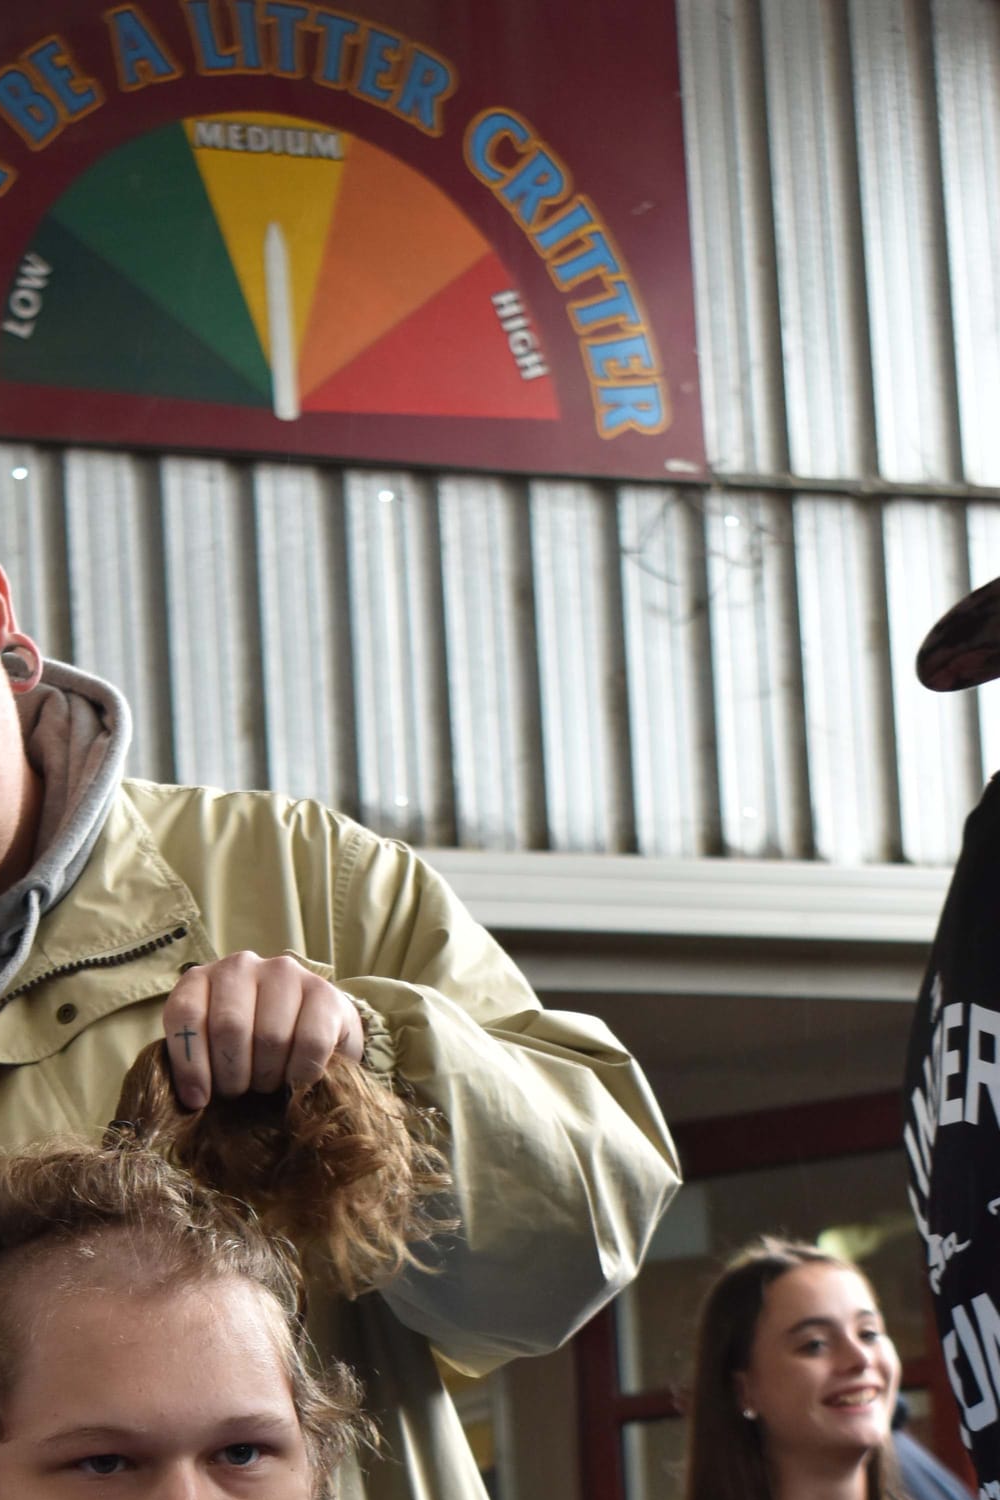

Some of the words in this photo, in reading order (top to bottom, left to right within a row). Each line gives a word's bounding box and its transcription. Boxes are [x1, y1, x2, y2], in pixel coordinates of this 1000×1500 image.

[194, 121, 344, 161] MEDIUM
[103, 2, 184, 93] A
[181, 0, 457, 137] LITTER
[463, 105, 672, 440] CRITTER
[2, 253, 53, 340] LOW
[491, 290, 548, 381] HIGH
